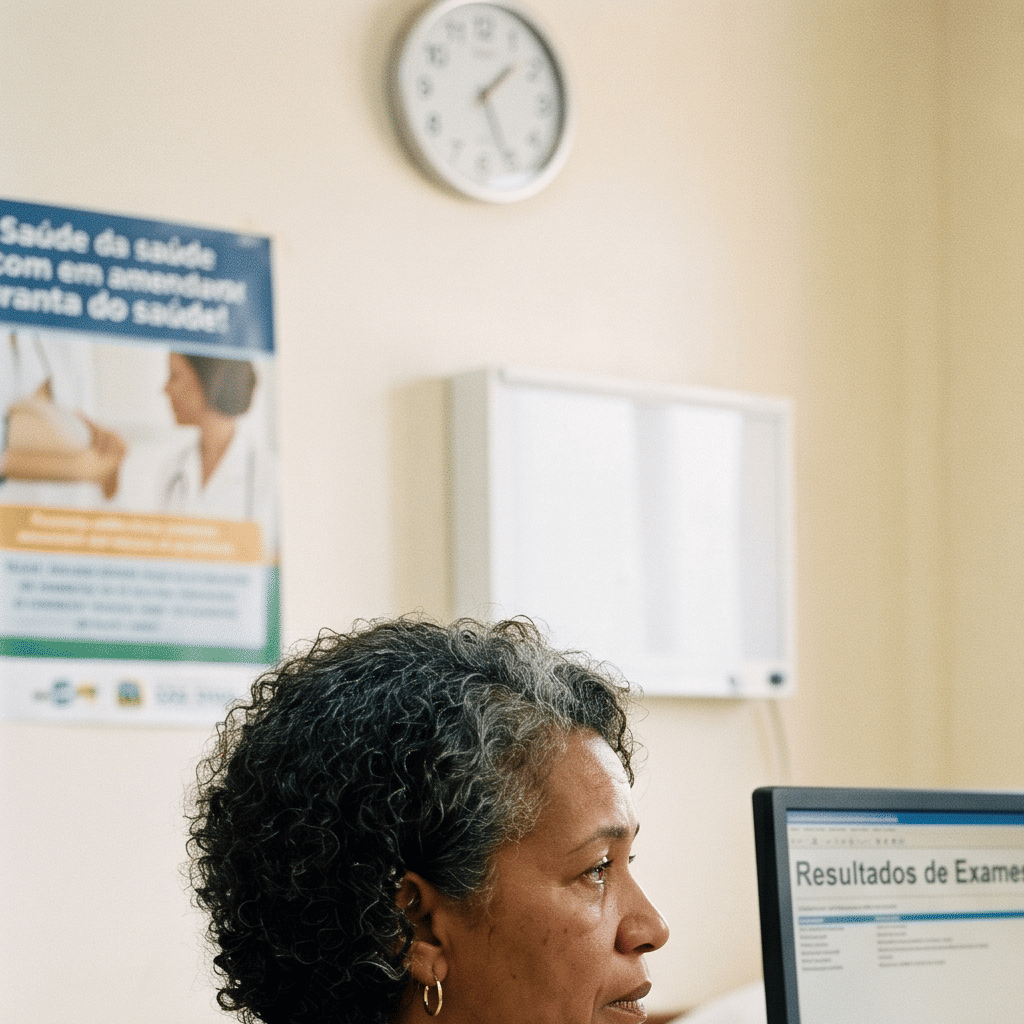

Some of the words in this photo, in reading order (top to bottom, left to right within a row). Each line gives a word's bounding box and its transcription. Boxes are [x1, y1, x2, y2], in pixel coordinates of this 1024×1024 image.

[0, 215, 90, 254] Saúde
[93, 227, 131, 259] da
[57, 259, 104, 287] em
[87, 288, 129, 323] do
[796, 860, 917, 886] Resultados
[924, 860, 949, 885] de
